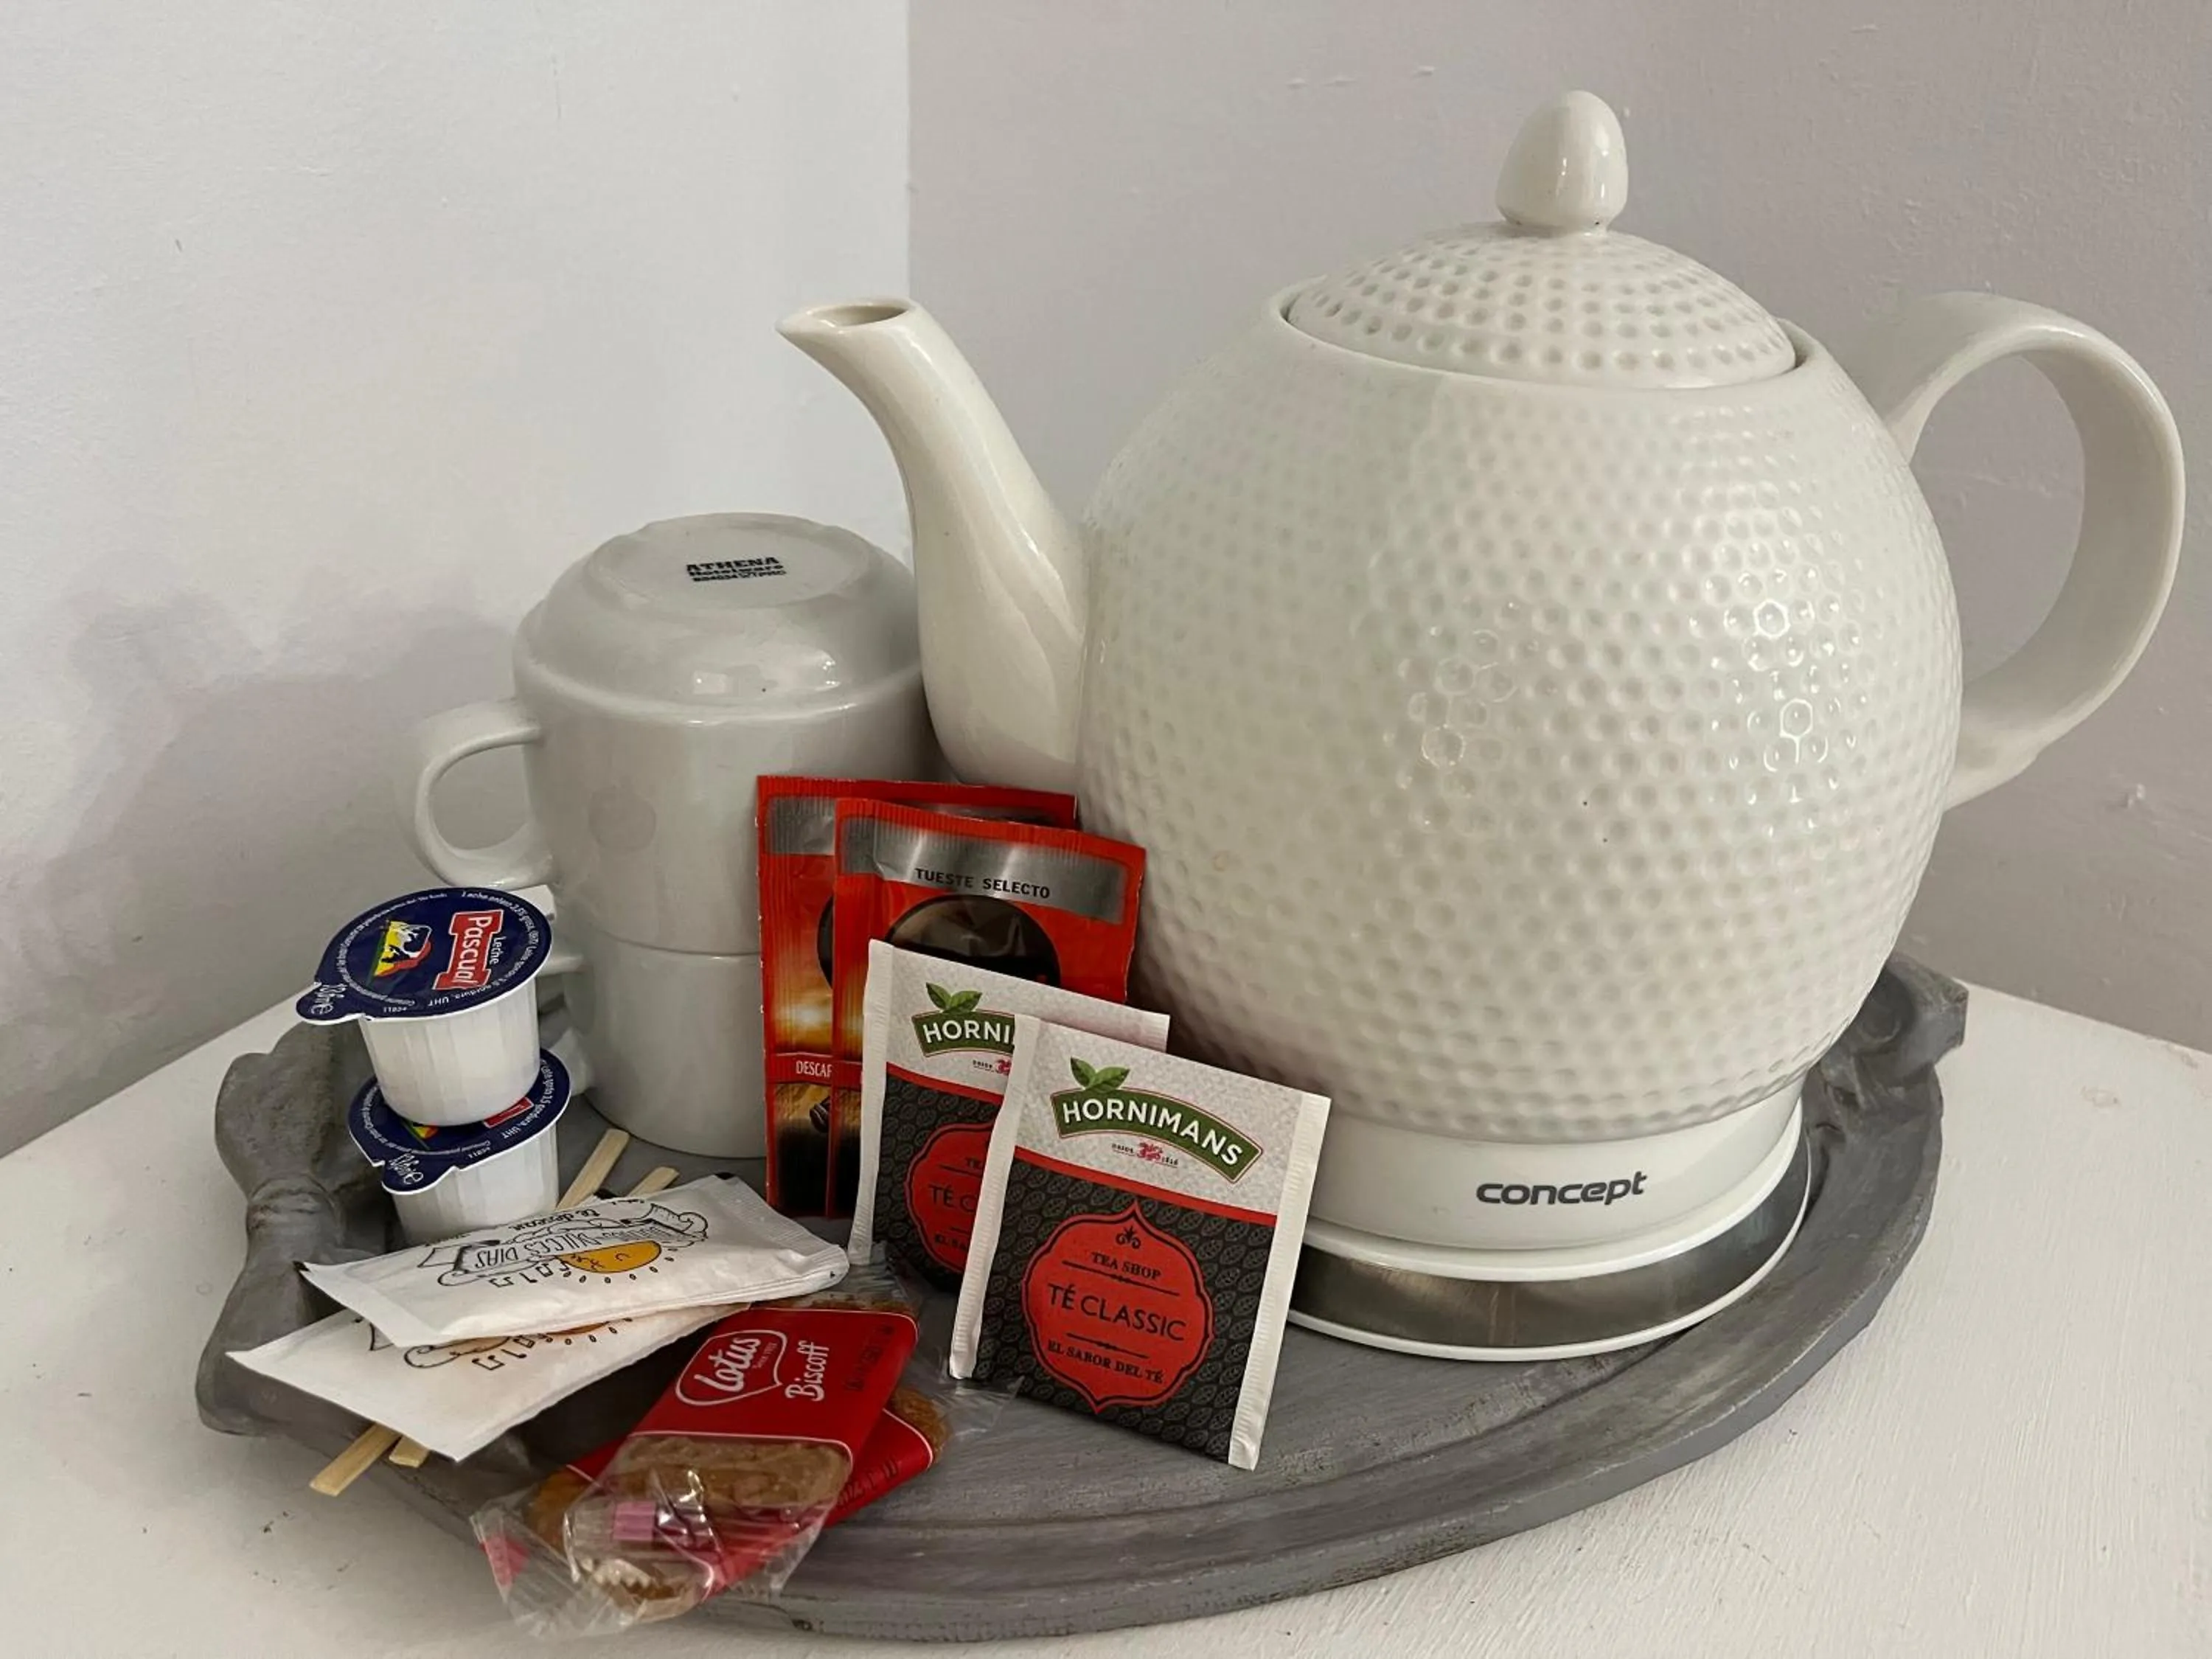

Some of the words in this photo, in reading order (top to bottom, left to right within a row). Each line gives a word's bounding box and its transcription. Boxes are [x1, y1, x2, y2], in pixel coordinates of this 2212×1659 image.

[686, 557, 779, 572] ATHENA
[914, 868, 974, 889] TUESTE
[982, 877, 1051, 899] SELECTO
[451, 916, 493, 984] Pascual
[489, 935, 507, 965] Leche
[428, 996, 449, 1006] UHT
[922, 1020, 1015, 1045] HORNI
[796, 1060, 832, 1078] DESCAF
[501, 1125, 521, 1139] UHT
[1062, 1098, 1243, 1166] HORNIMANS
[928, 1183, 956, 1208] TÉ
[1475, 1171, 1648, 1206] concept
[576, 1208, 601, 1217] te
[524, 1231, 602, 1256] DULCES
[1092, 1251, 1119, 1270] TEA
[1121, 1261, 1161, 1280] SHOP
[1047, 1282, 1077, 1310] TÉ
[1080, 1295, 1187, 1341] CLASSIC
[694, 1337, 762, 1392] Lotus
[785, 1340, 830, 1402] Biscoff
[1048, 1340, 1065, 1355] EL
[1066, 1346, 1112, 1369] SABOR
[1114, 1360, 1143, 1379] DEL
[1144, 1369, 1164, 1385] TÉ
